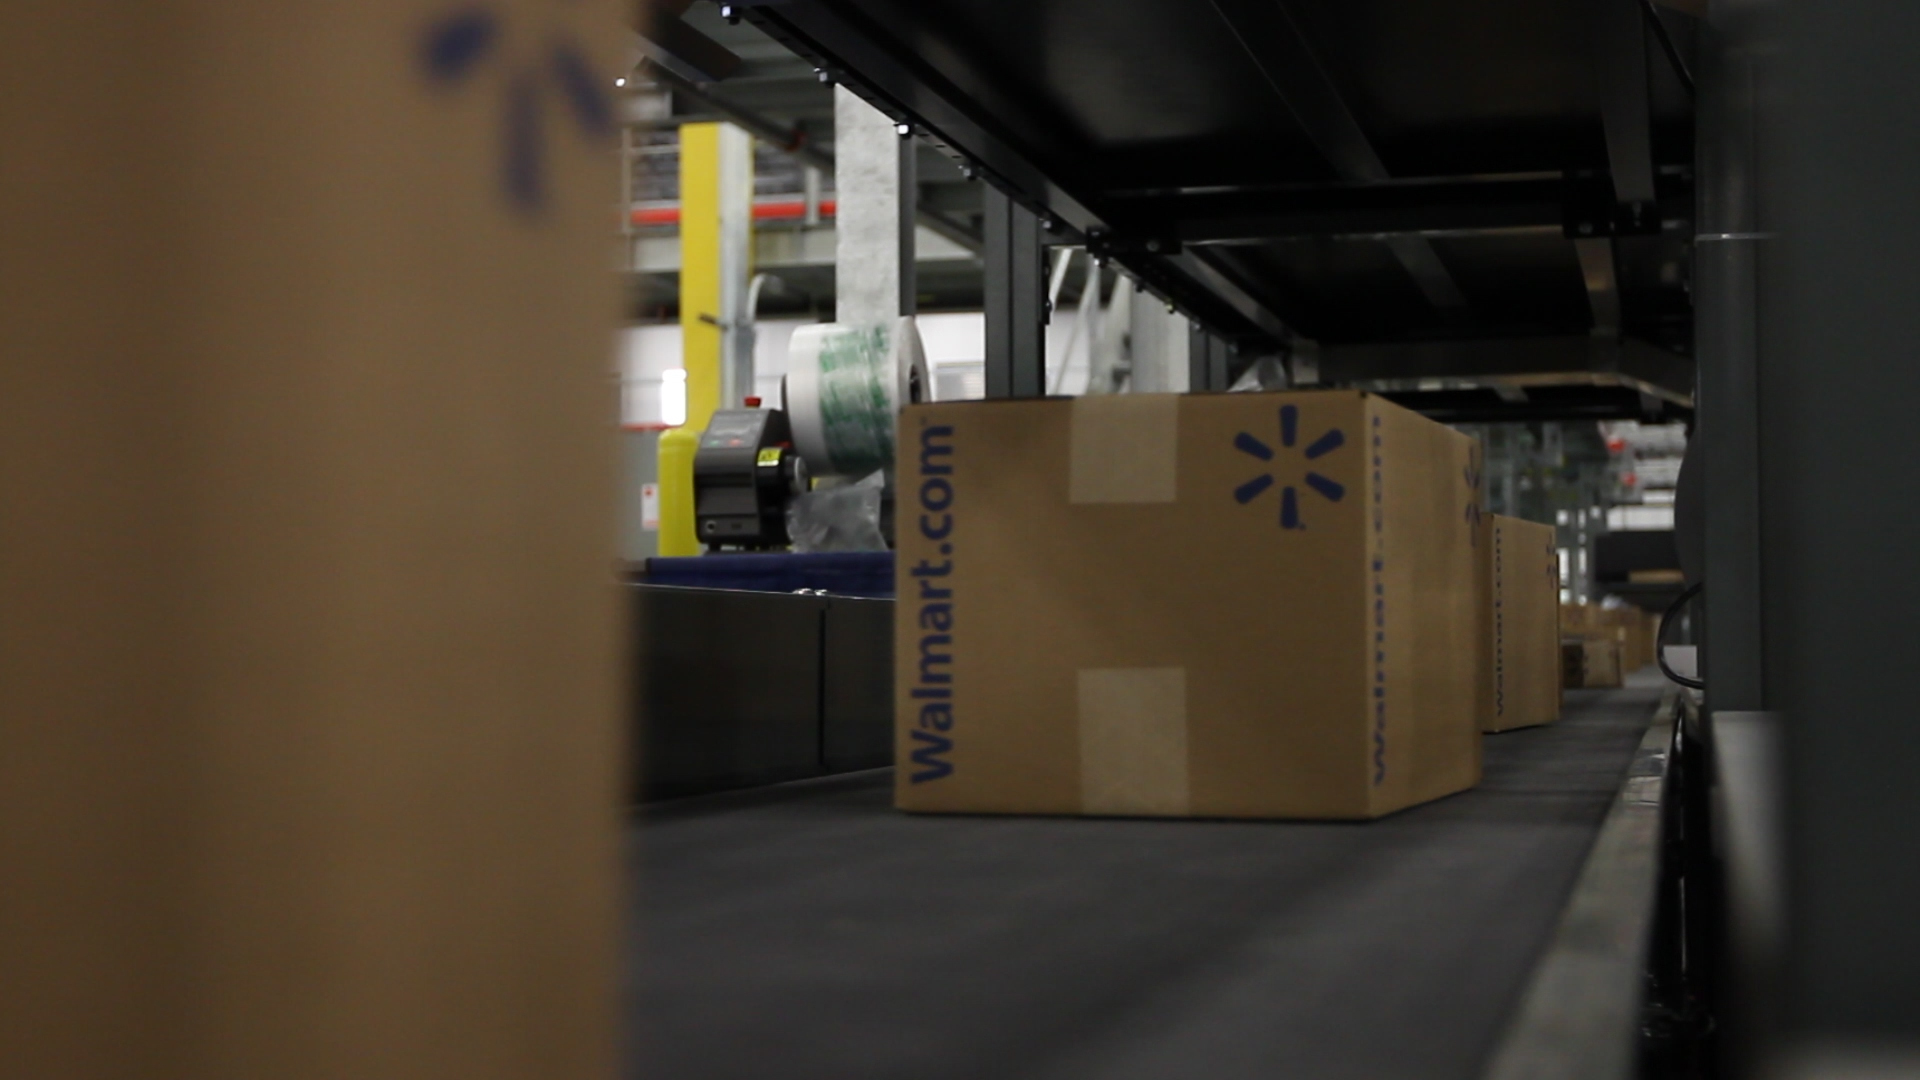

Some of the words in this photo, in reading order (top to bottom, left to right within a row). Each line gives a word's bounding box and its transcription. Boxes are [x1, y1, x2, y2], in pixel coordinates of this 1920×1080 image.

[909, 425, 955, 785] Walmart.com
[1371, 415, 1387, 786] Walmart.com
[1495, 527, 1505, 716] Walmart.com
